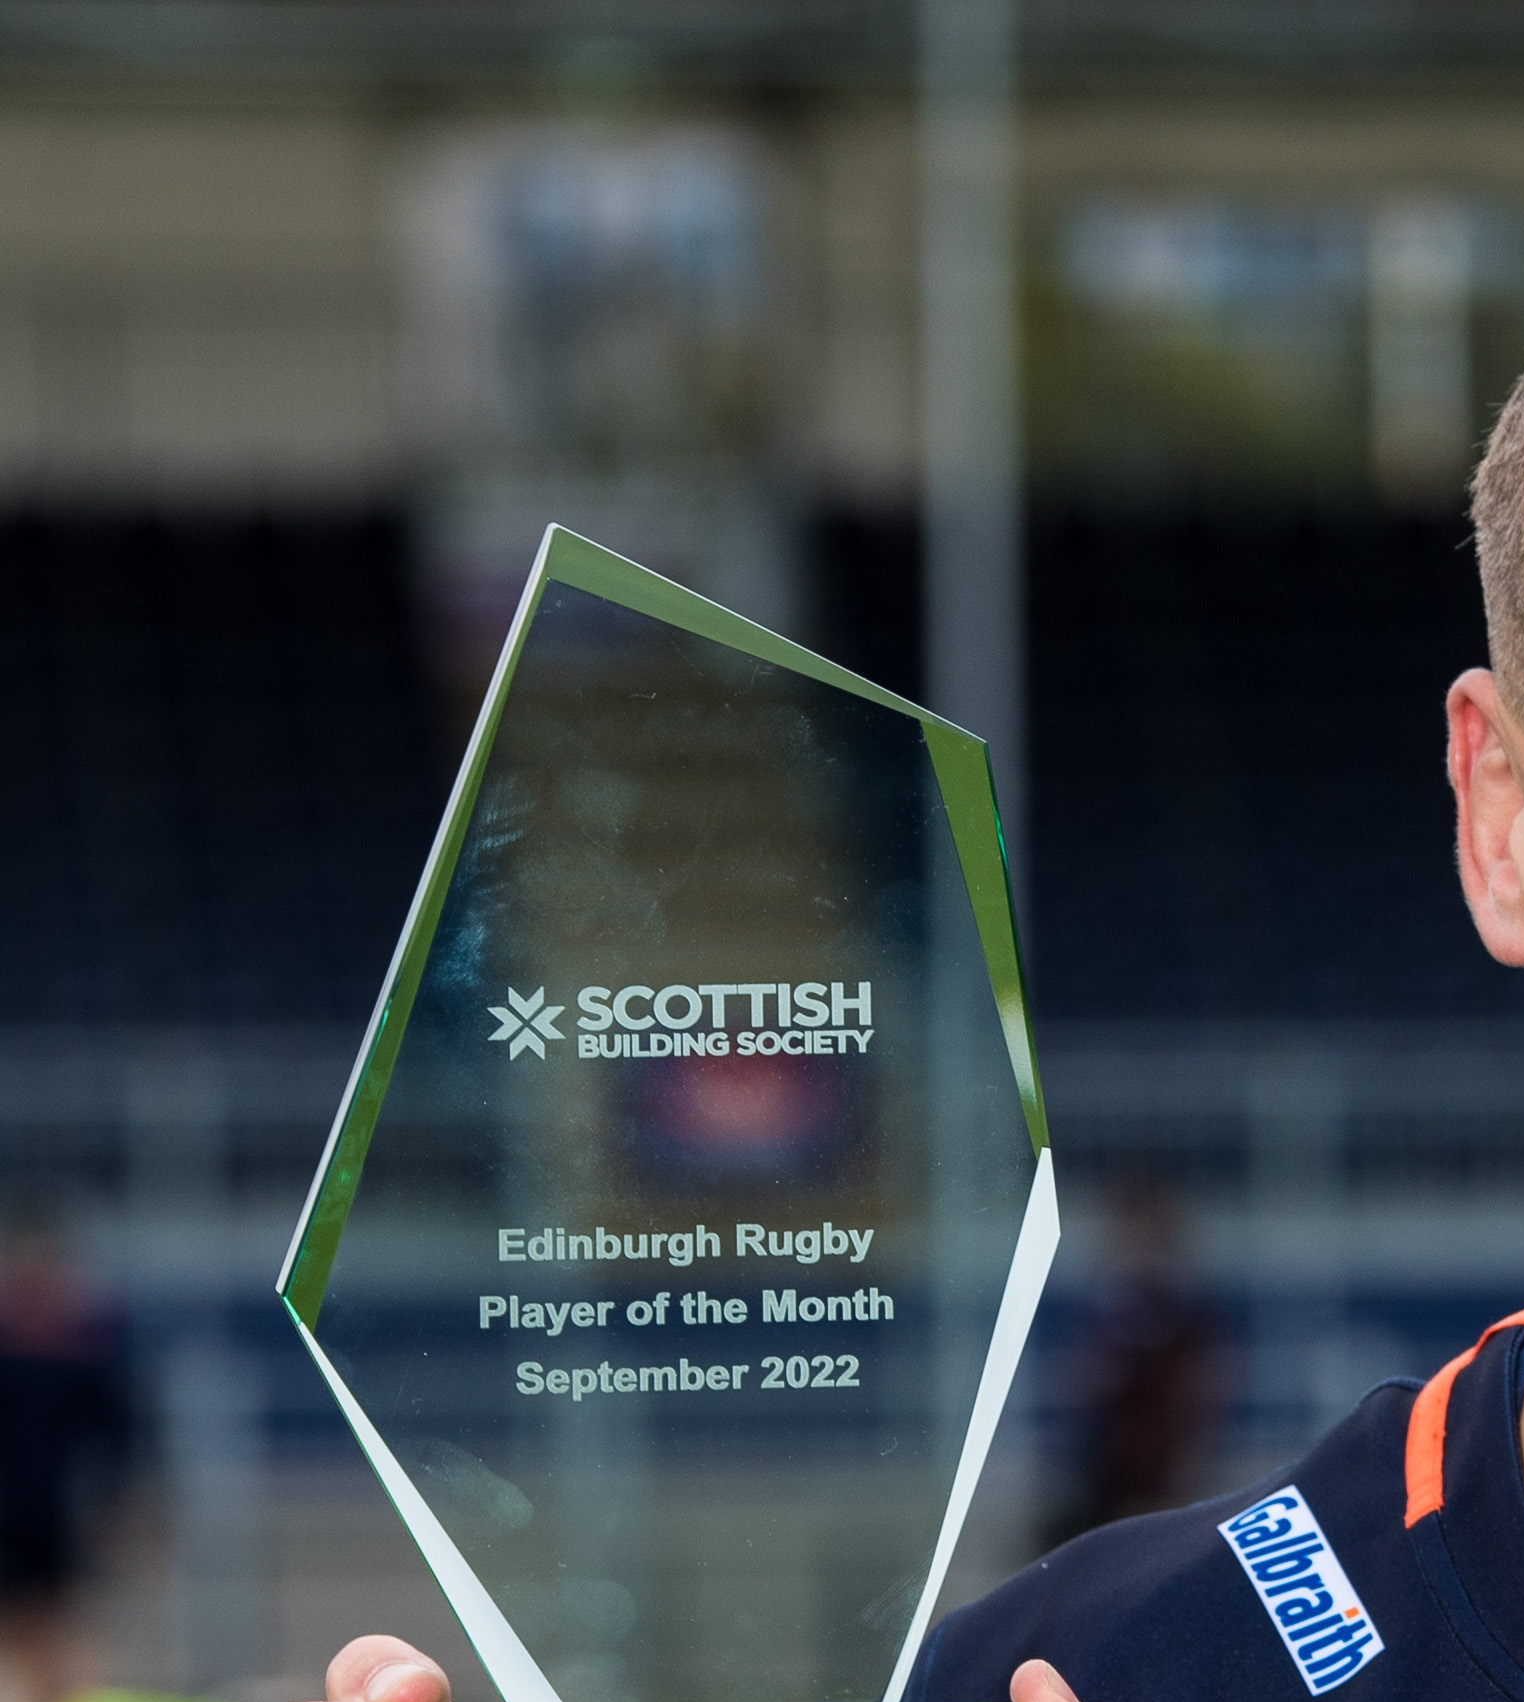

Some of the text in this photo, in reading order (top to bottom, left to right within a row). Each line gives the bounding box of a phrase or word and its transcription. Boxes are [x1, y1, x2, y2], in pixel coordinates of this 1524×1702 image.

[577, 981, 873, 1031] SCOTTISH
[578, 1029, 874, 1059] BUILDING SOCIETY
[498, 1222, 874, 1266] Edinburgh Rugby
[479, 1287, 894, 1336] Player of the Month
[516, 1355, 860, 1402] September 2022
[1228, 1496, 1373, 1689] Galbraith
